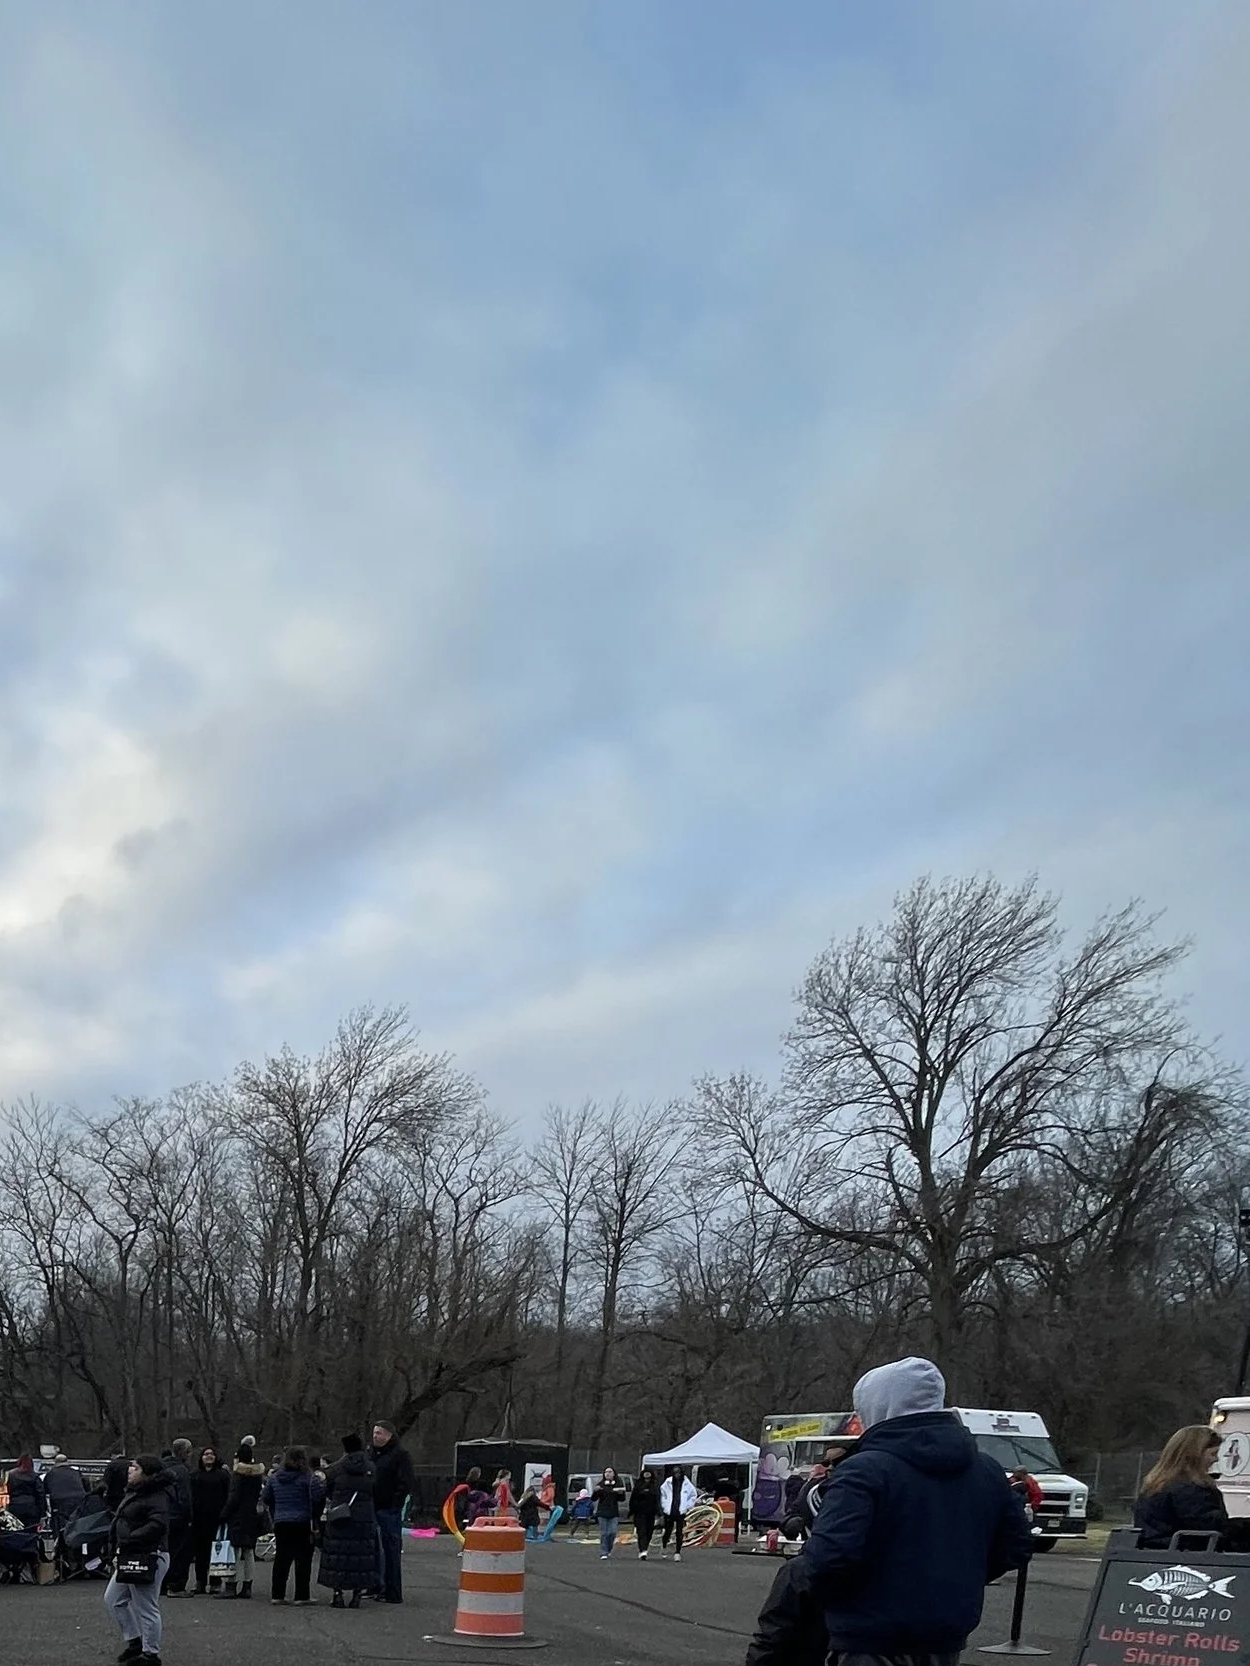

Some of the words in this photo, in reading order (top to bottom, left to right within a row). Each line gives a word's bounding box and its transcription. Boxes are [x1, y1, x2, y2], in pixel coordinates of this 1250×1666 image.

[1118, 1602, 1232, 1622] L'ACQUARIO
[1098, 1624, 1180, 1646] Lobster
[1183, 1632, 1240, 1653] Rolls
